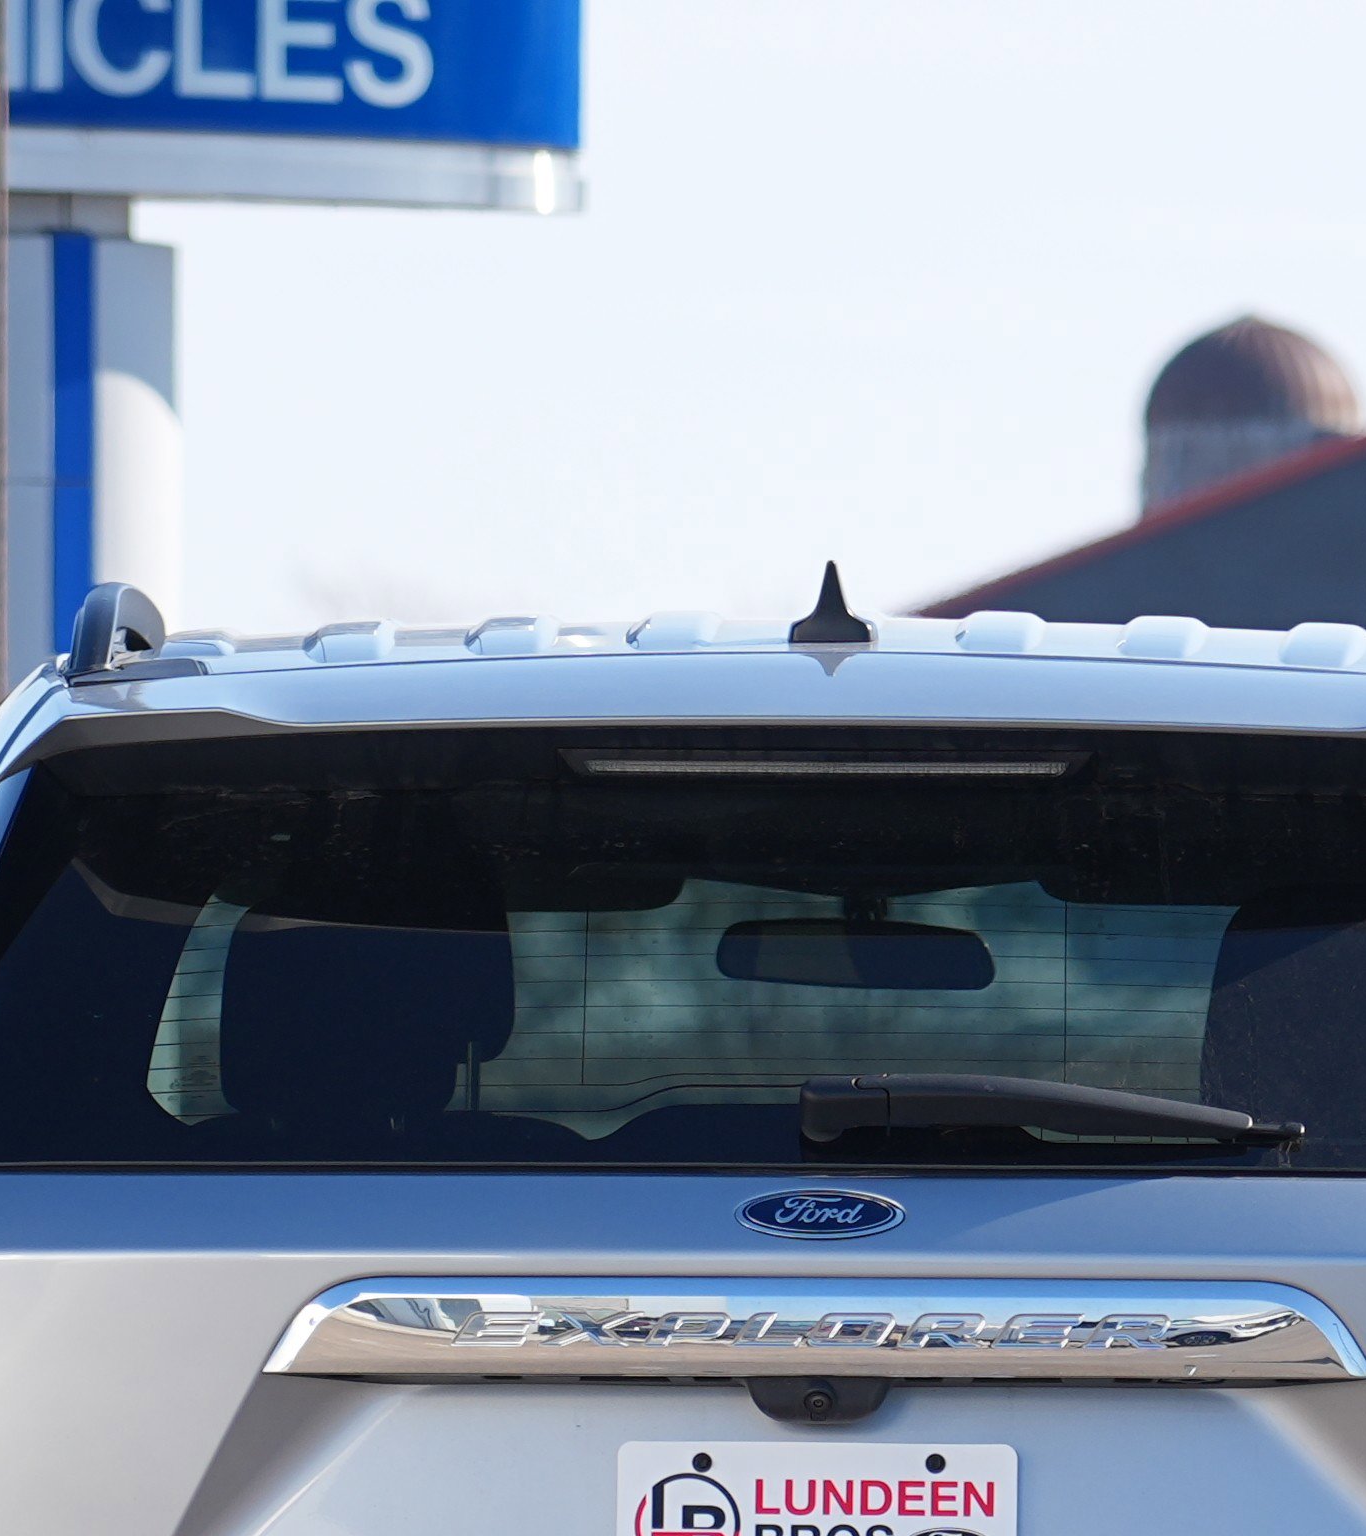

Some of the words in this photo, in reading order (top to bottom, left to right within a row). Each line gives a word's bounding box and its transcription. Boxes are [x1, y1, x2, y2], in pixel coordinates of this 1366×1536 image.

[774, 1195, 865, 1224] Ford
[450, 1311, 1172, 1349] EXPLORER
[754, 1479, 995, 1518] LUNDEEN
